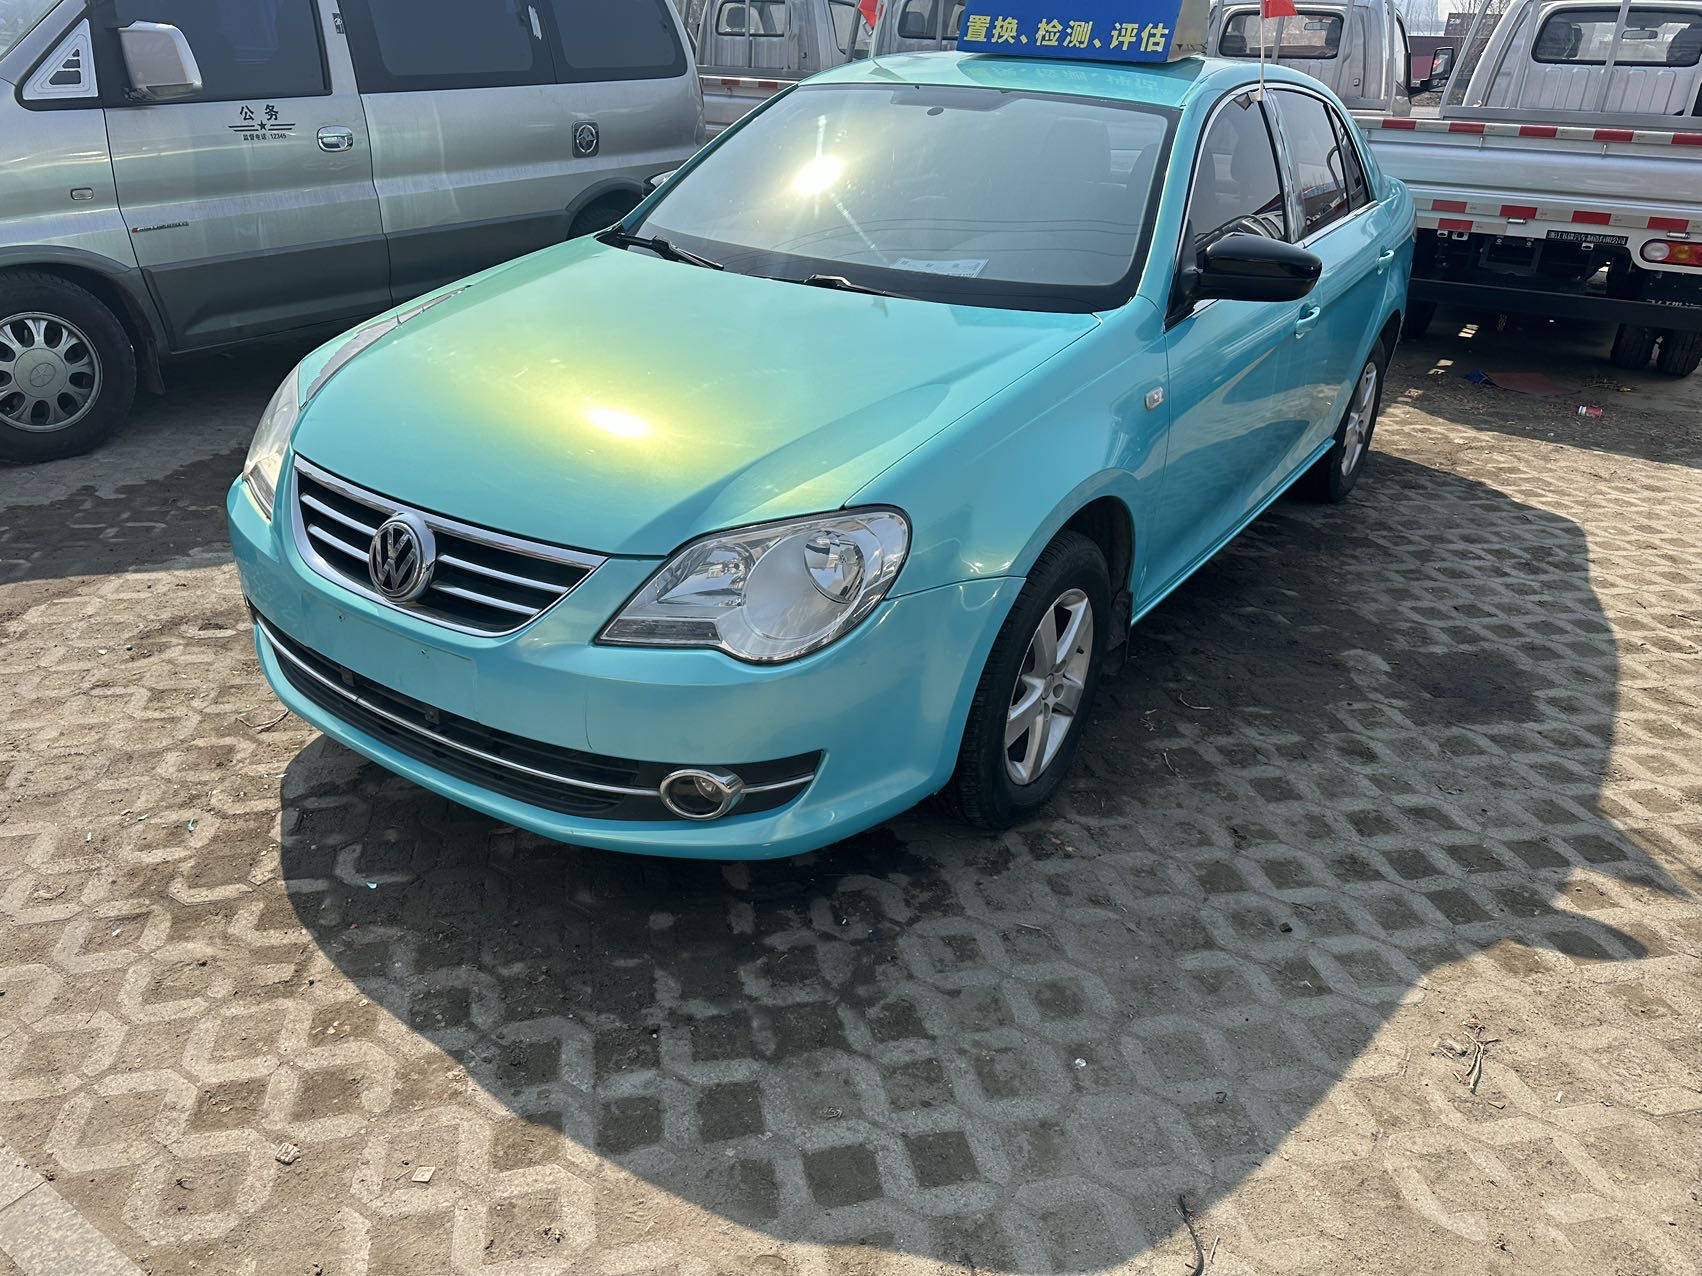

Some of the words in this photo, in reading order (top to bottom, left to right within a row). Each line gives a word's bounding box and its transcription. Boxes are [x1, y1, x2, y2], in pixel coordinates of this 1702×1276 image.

[963, 14, 1169, 52] 置换、检测、评估
[239, 103, 279, 121] 公务
